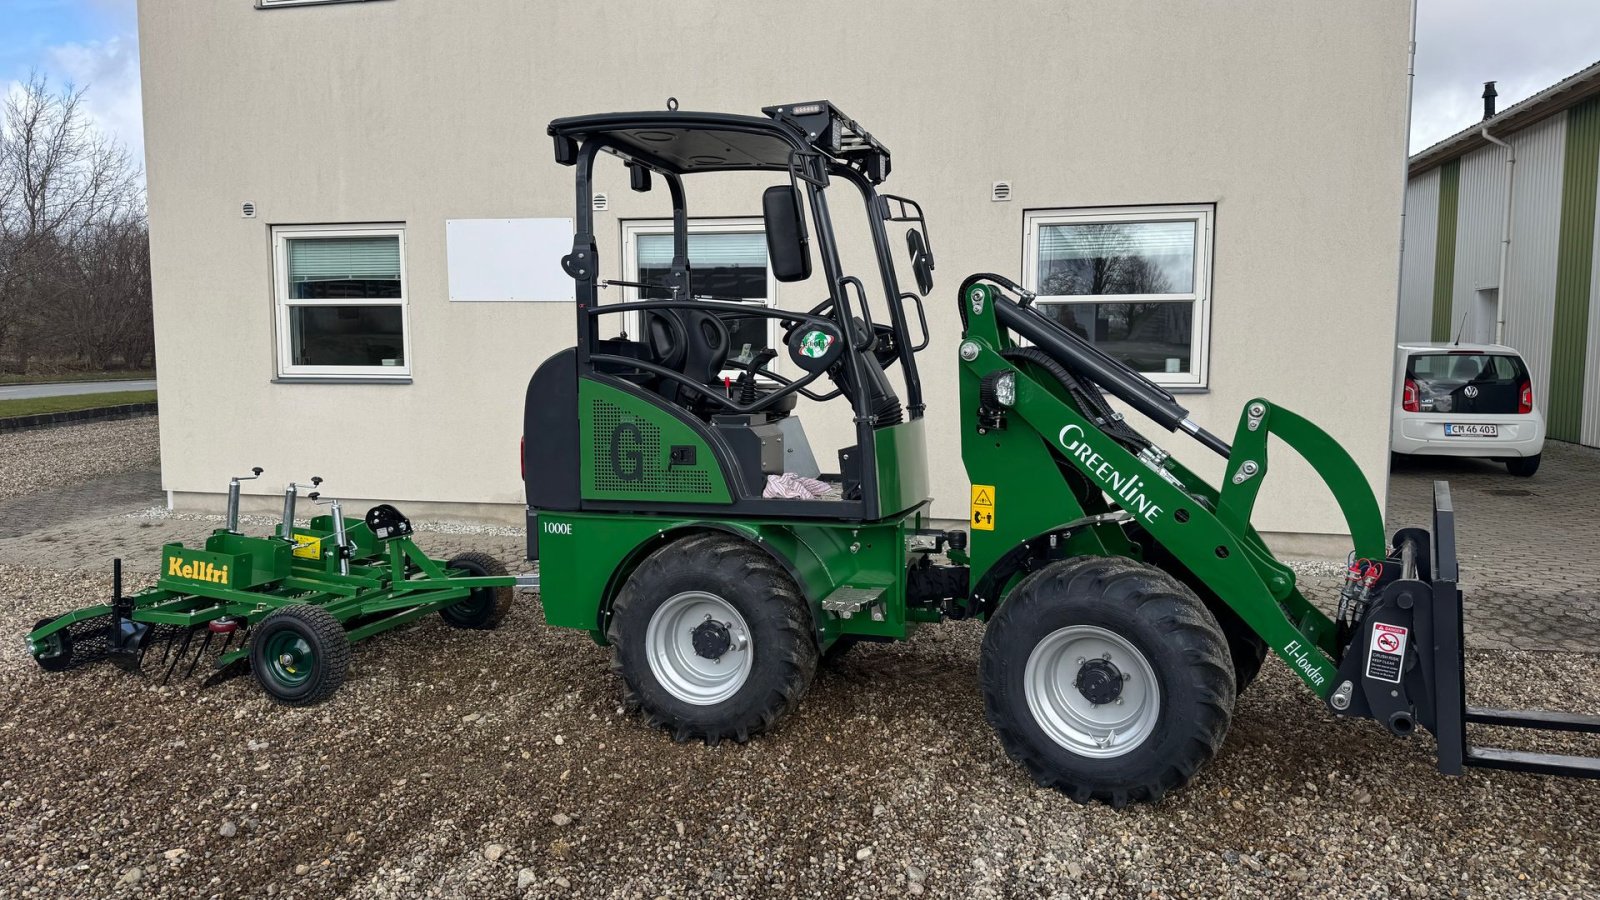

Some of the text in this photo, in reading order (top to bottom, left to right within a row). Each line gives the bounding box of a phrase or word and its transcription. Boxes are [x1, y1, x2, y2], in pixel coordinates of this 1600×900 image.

[1452, 425, 1465, 433] CM
[1466, 425, 1478, 433] 46
[1479, 425, 1496, 434] 403
[611, 422, 644, 481] G
[543, 521, 573, 535] 1000E
[168, 556, 228, 584] Kellfri
